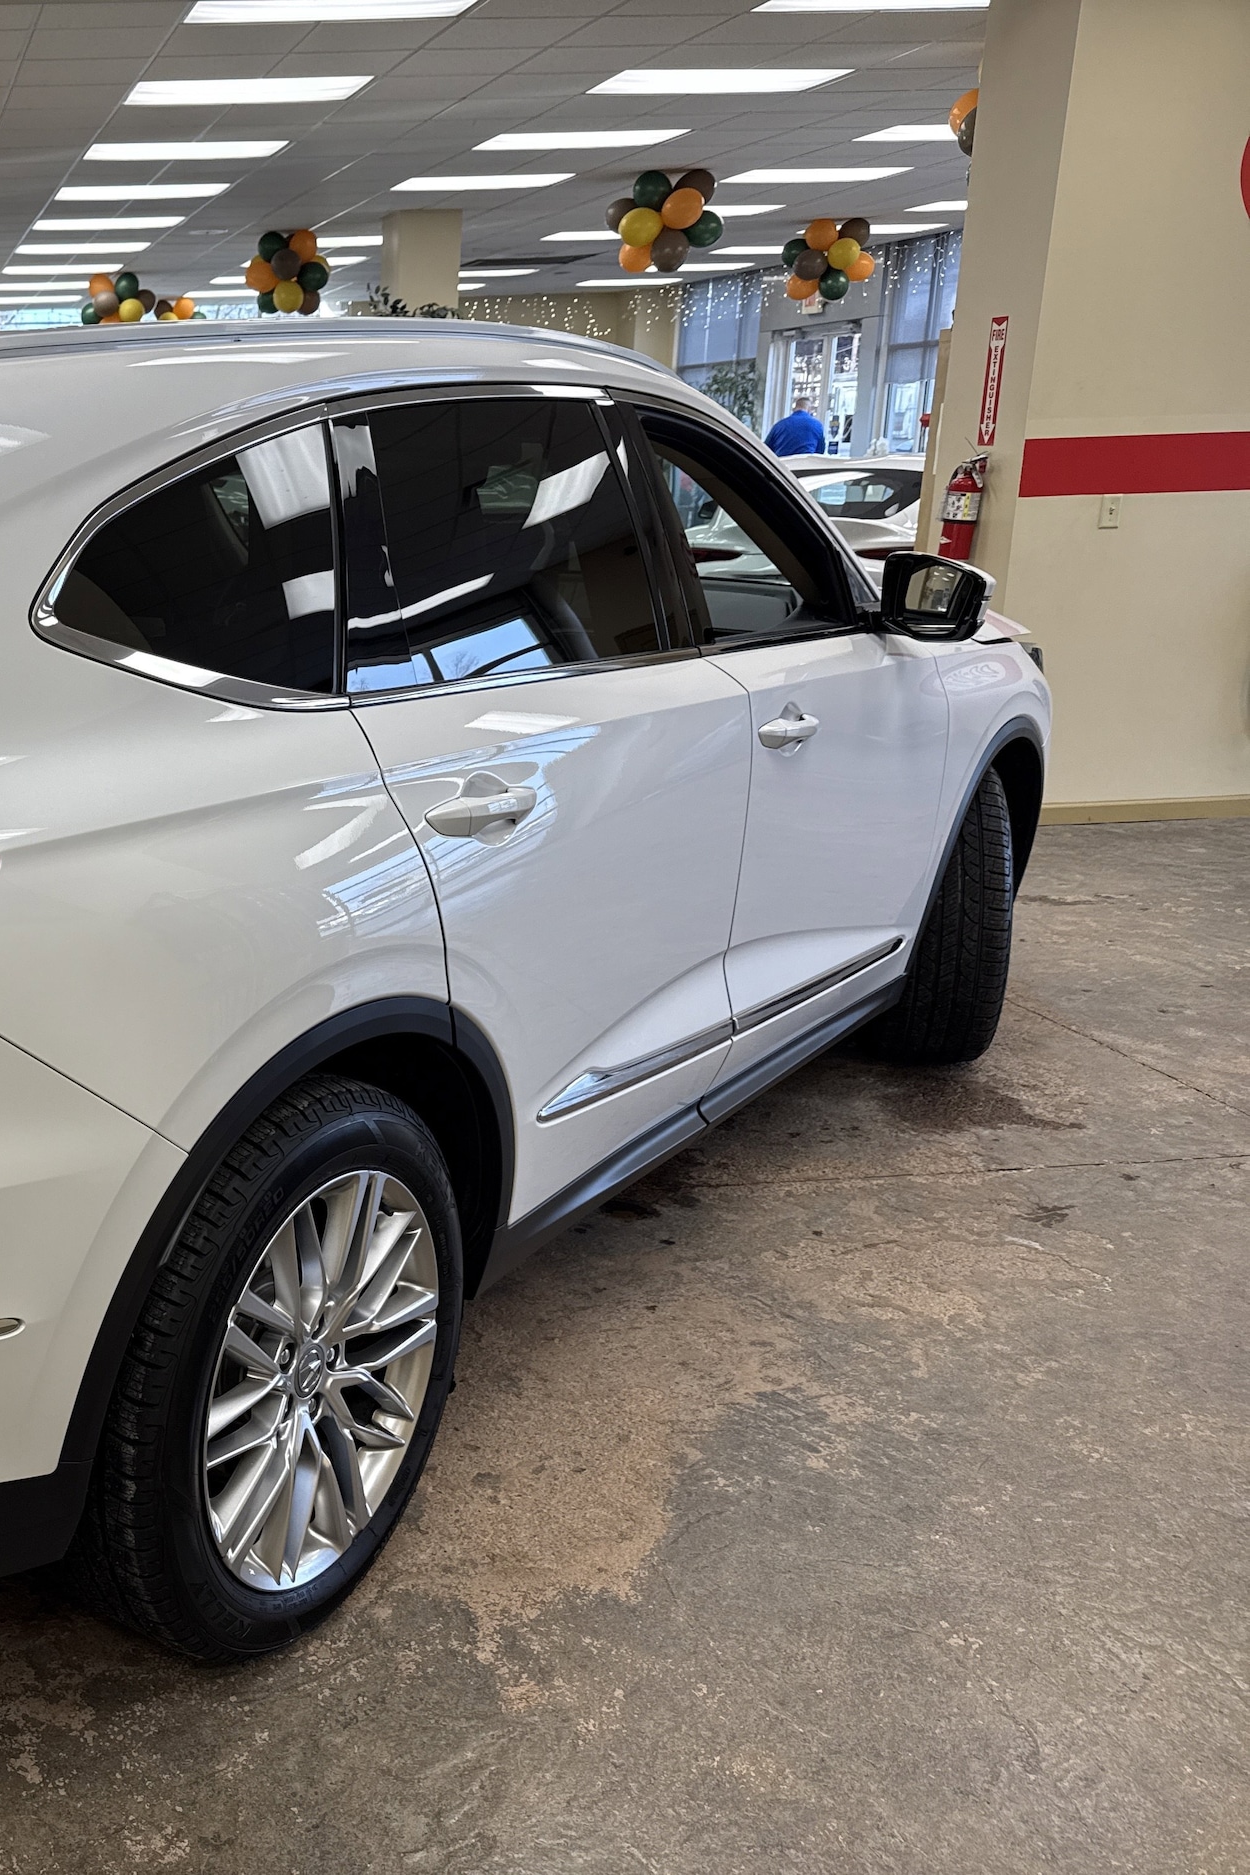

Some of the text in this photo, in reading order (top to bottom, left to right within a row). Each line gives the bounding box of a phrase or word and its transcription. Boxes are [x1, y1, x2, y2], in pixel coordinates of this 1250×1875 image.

[991, 328, 1005, 341] FIRE
[984, 345, 1000, 437] EXTINGUISHER
[187, 1580, 253, 1639] KELLY
